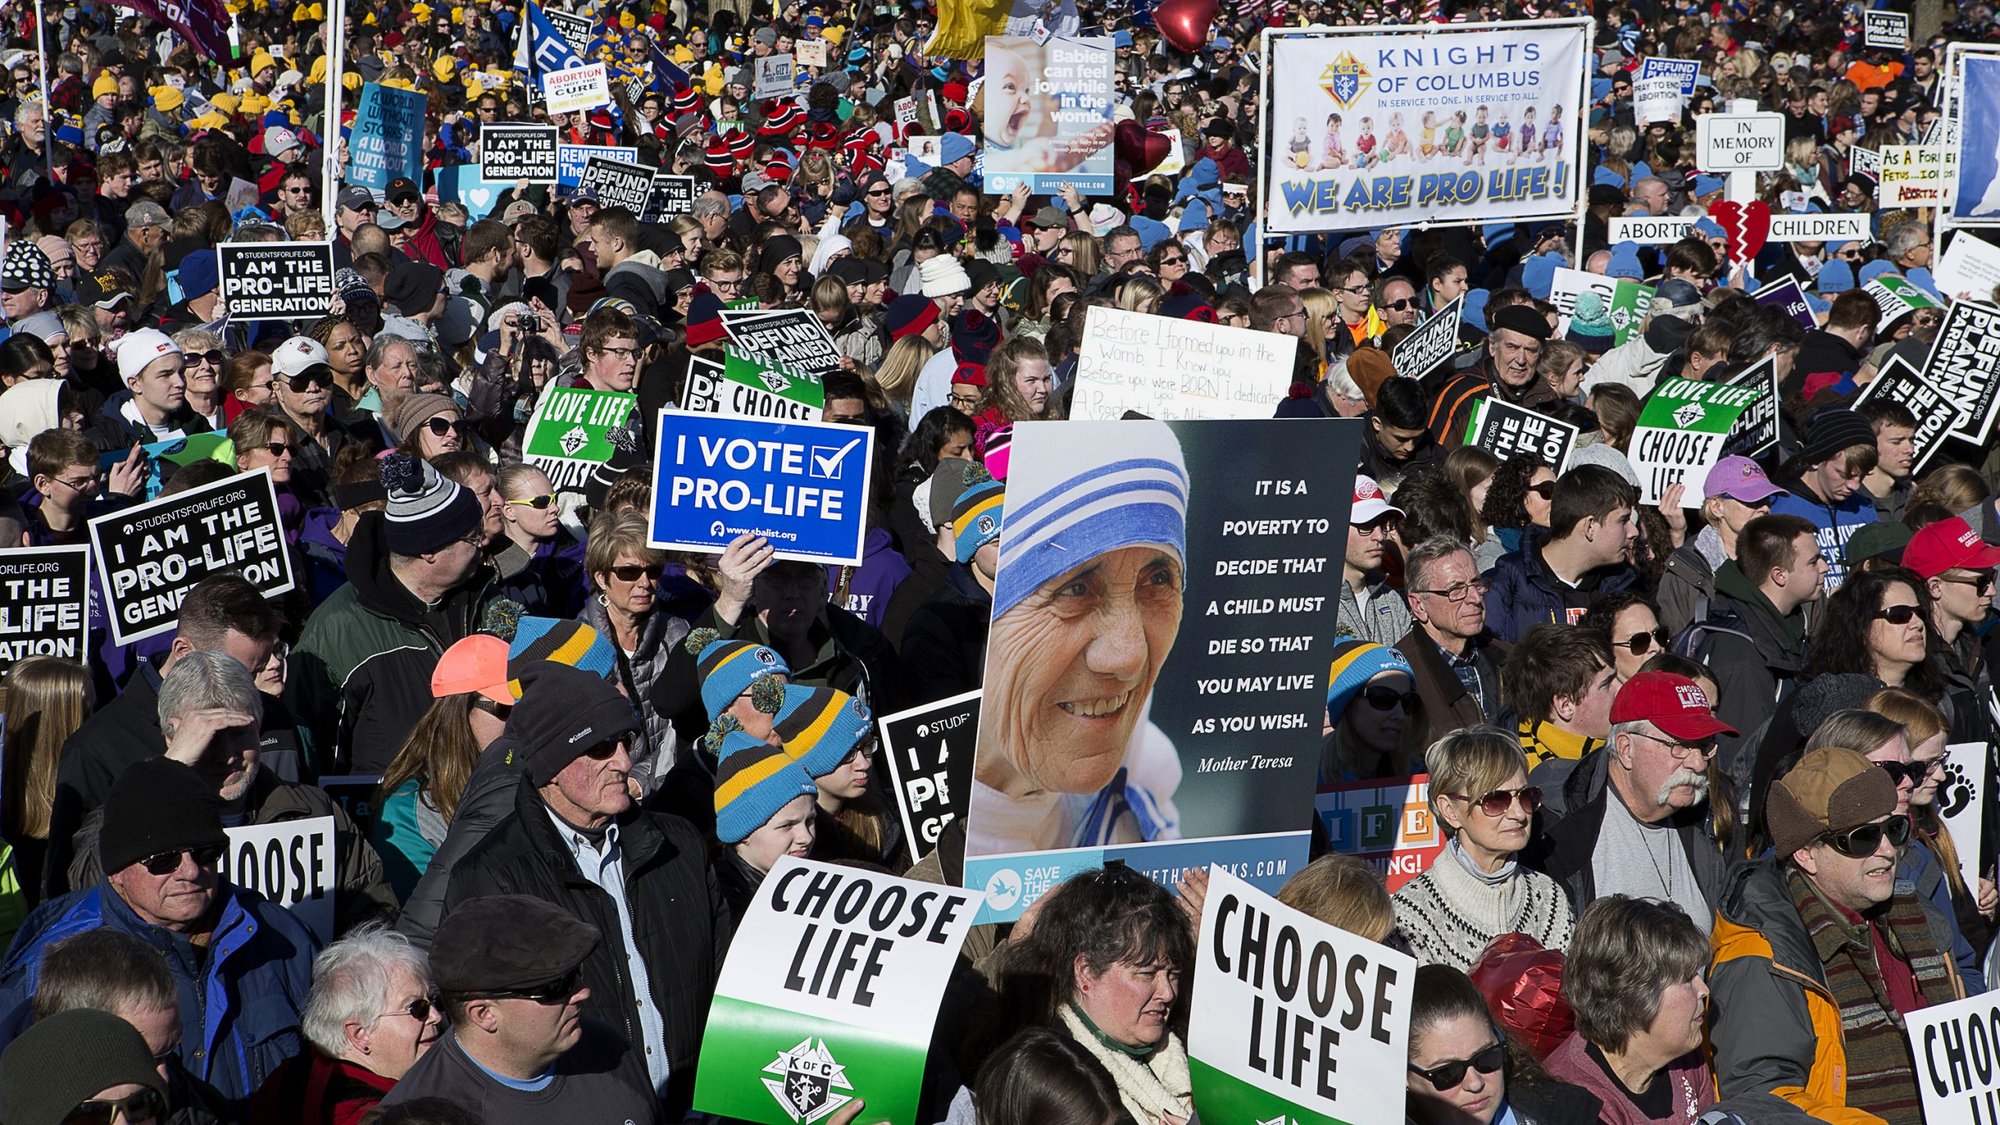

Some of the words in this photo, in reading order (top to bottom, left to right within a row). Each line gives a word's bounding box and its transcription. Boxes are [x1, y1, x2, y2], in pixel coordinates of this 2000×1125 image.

[569, 22, 588, 33] THE
[1052, 49, 1107, 64] Babies
[1378, 42, 1541, 69] KNIGHTS
[549, 68, 602, 85] ABORTION
[1043, 65, 1074, 78] can
[1077, 64, 1107, 78] feel
[1333, 65, 1340, 74] K
[1341, 65, 1351, 73] OF
[1352, 64, 1359, 74] C
[1648, 60, 1695, 74] DEFUND
[555, 83, 598, 96] CURE
[1034, 80, 1059, 95] joy
[1063, 78, 1107, 93] while
[1377, 77, 1408, 93] OF
[1416, 71, 1540, 92] COLUMBUS
[1653, 82, 1665, 90] TO
[370, 91, 380, 103] A
[379, 92, 414, 110] WORLD
[1061, 94, 1076, 108] in
[1079, 94, 1107, 108] the
[1377, 99, 1387, 109] IN
[1390, 97, 1425, 107] SERVICE
[1464, 94, 1473, 104] IN
[1475, 93, 1509, 104] SERVICE
[1638, 92, 1678, 102] ABORTION
[367, 105, 414, 126] WITHOUT
[1050, 109, 1108, 124] womb.
[363, 121, 404, 137] STORKS
[403, 129, 413, 141] IS
[1737, 122, 1752, 134] IN
[358, 136, 368, 150] A
[369, 137, 407, 156] WORLD
[487, 140, 492, 150] I
[497, 140, 520, 150] AM
[523, 139, 551, 150] THE
[1712, 137, 1775, 149] MEMORY
[355, 151, 407, 172] WITHOUT
[484, 150, 556, 165] PRO-LIFE
[561, 149, 633, 164] REMEMBER
[1734, 152, 1753, 164] OF
[1883, 151, 1898, 165] AS
[1904, 152, 1911, 165] A
[352, 167, 377, 183] LIFE
[485, 166, 554, 177] GENERATION
[561, 163, 583, 178] The
[585, 166, 650, 192] DEFUND
[661, 188, 687, 199] THE
[1280, 177, 1339, 214] WE
[1343, 173, 1413, 209] ARE
[1417, 169, 1483, 205] PRO
[1487, 164, 1549, 200] LIFE
[1619, 224, 1693, 238] ABORT
[1772, 220, 1860, 236] CHILDREN
[244, 251, 315, 259] STUDENTSFORLIFE.ORG
[230, 262, 236, 275] I
[245, 261, 276, 275] AM
[285, 260, 323, 273] THE
[226, 275, 331, 296] PRO-LIFE
[229, 296, 330, 313] GENERATION
[738, 323, 821, 352] DEFUND
[1154, 319, 1164, 346] I
[1166, 321, 1215, 352] formed
[1215, 342, 1234, 358] you
[1239, 342, 1250, 358] in
[1256, 342, 1276, 363] the
[1395, 311, 1457, 368] DEFUND
[1157, 347, 1165, 368] I
[1928, 306, 1973, 390] PARENTH
[1079, 355, 1124, 384] Before
[1128, 375, 1147, 391] you
[1151, 376, 1177, 391] were
[1181, 373, 1219, 397] BORN
[1225, 380, 1231, 400] I
[1233, 383, 1280, 406] dedicate
[1951, 314, 2000, 430] DEFUND
[1073, 388, 1087, 412] A
[1657, 379, 1708, 402] LOVE
[1707, 385, 1757, 408] LIFE
[544, 391, 591, 425] LOVE
[589, 396, 630, 428] LIFE
[676, 434, 686, 465] I
[698, 436, 804, 475] VOTE
[1640, 431, 1713, 466] CHOOSE
[1255, 481, 1272, 496] IT
[1275, 480, 1291, 495] IS
[1294, 480, 1308, 495] A
[1651, 467, 1685, 501] LIFE
[670, 476, 844, 521] PRO-LIFE
[135, 489, 247, 532] STUDENTSFORLIFE.ORG
[115, 543, 124, 564] I
[141, 524, 190, 557] AM
[201, 501, 262, 536] THE
[726, 526, 797, 542] www.sbalist.org
[1222, 520, 1303, 536] POVERTY
[1306, 519, 1330, 534] TO
[112, 523, 279, 600] PRO-LIFE
[1215, 560, 1278, 576] DECIDE
[1282, 558, 1326, 573] THAT
[5, 577, 71, 600] THE
[1206, 600, 1219, 615] A
[1223, 599, 1274, 615] CHILD
[1278, 597, 1325, 612] MUST
[0, 602, 80, 634] LIFE
[1208, 640, 1237, 655] DIE
[1240, 638, 1264, 653] SO
[1268, 636, 1313, 651] THAT
[1197, 678, 1233, 695] YOU
[1236, 676, 1273, 693] MAY
[1276, 675, 1314, 691] LIVE
[1678, 691, 1709, 706] LIFE
[1191, 718, 1215, 735] AS
[1219, 716, 1255, 732] YOU
[1259, 714, 1308, 730] WISH.
[908, 747, 920, 771] I
[1197, 757, 1248, 773] Mother
[1250, 754, 1293, 770] Teresa
[1024, 866, 1061, 881] SAVE
[1024, 879, 1051, 894] THE
[771, 866, 967, 945] CHOOSE
[783, 923, 895, 1008] LIFE
[1213, 893, 1398, 1046] CHOOSE
[1248, 994, 1340, 1102] LIFE
[788, 1056, 800, 1071] K
[803, 1060, 818, 1072] OF
[820, 1063, 832, 1077] C
